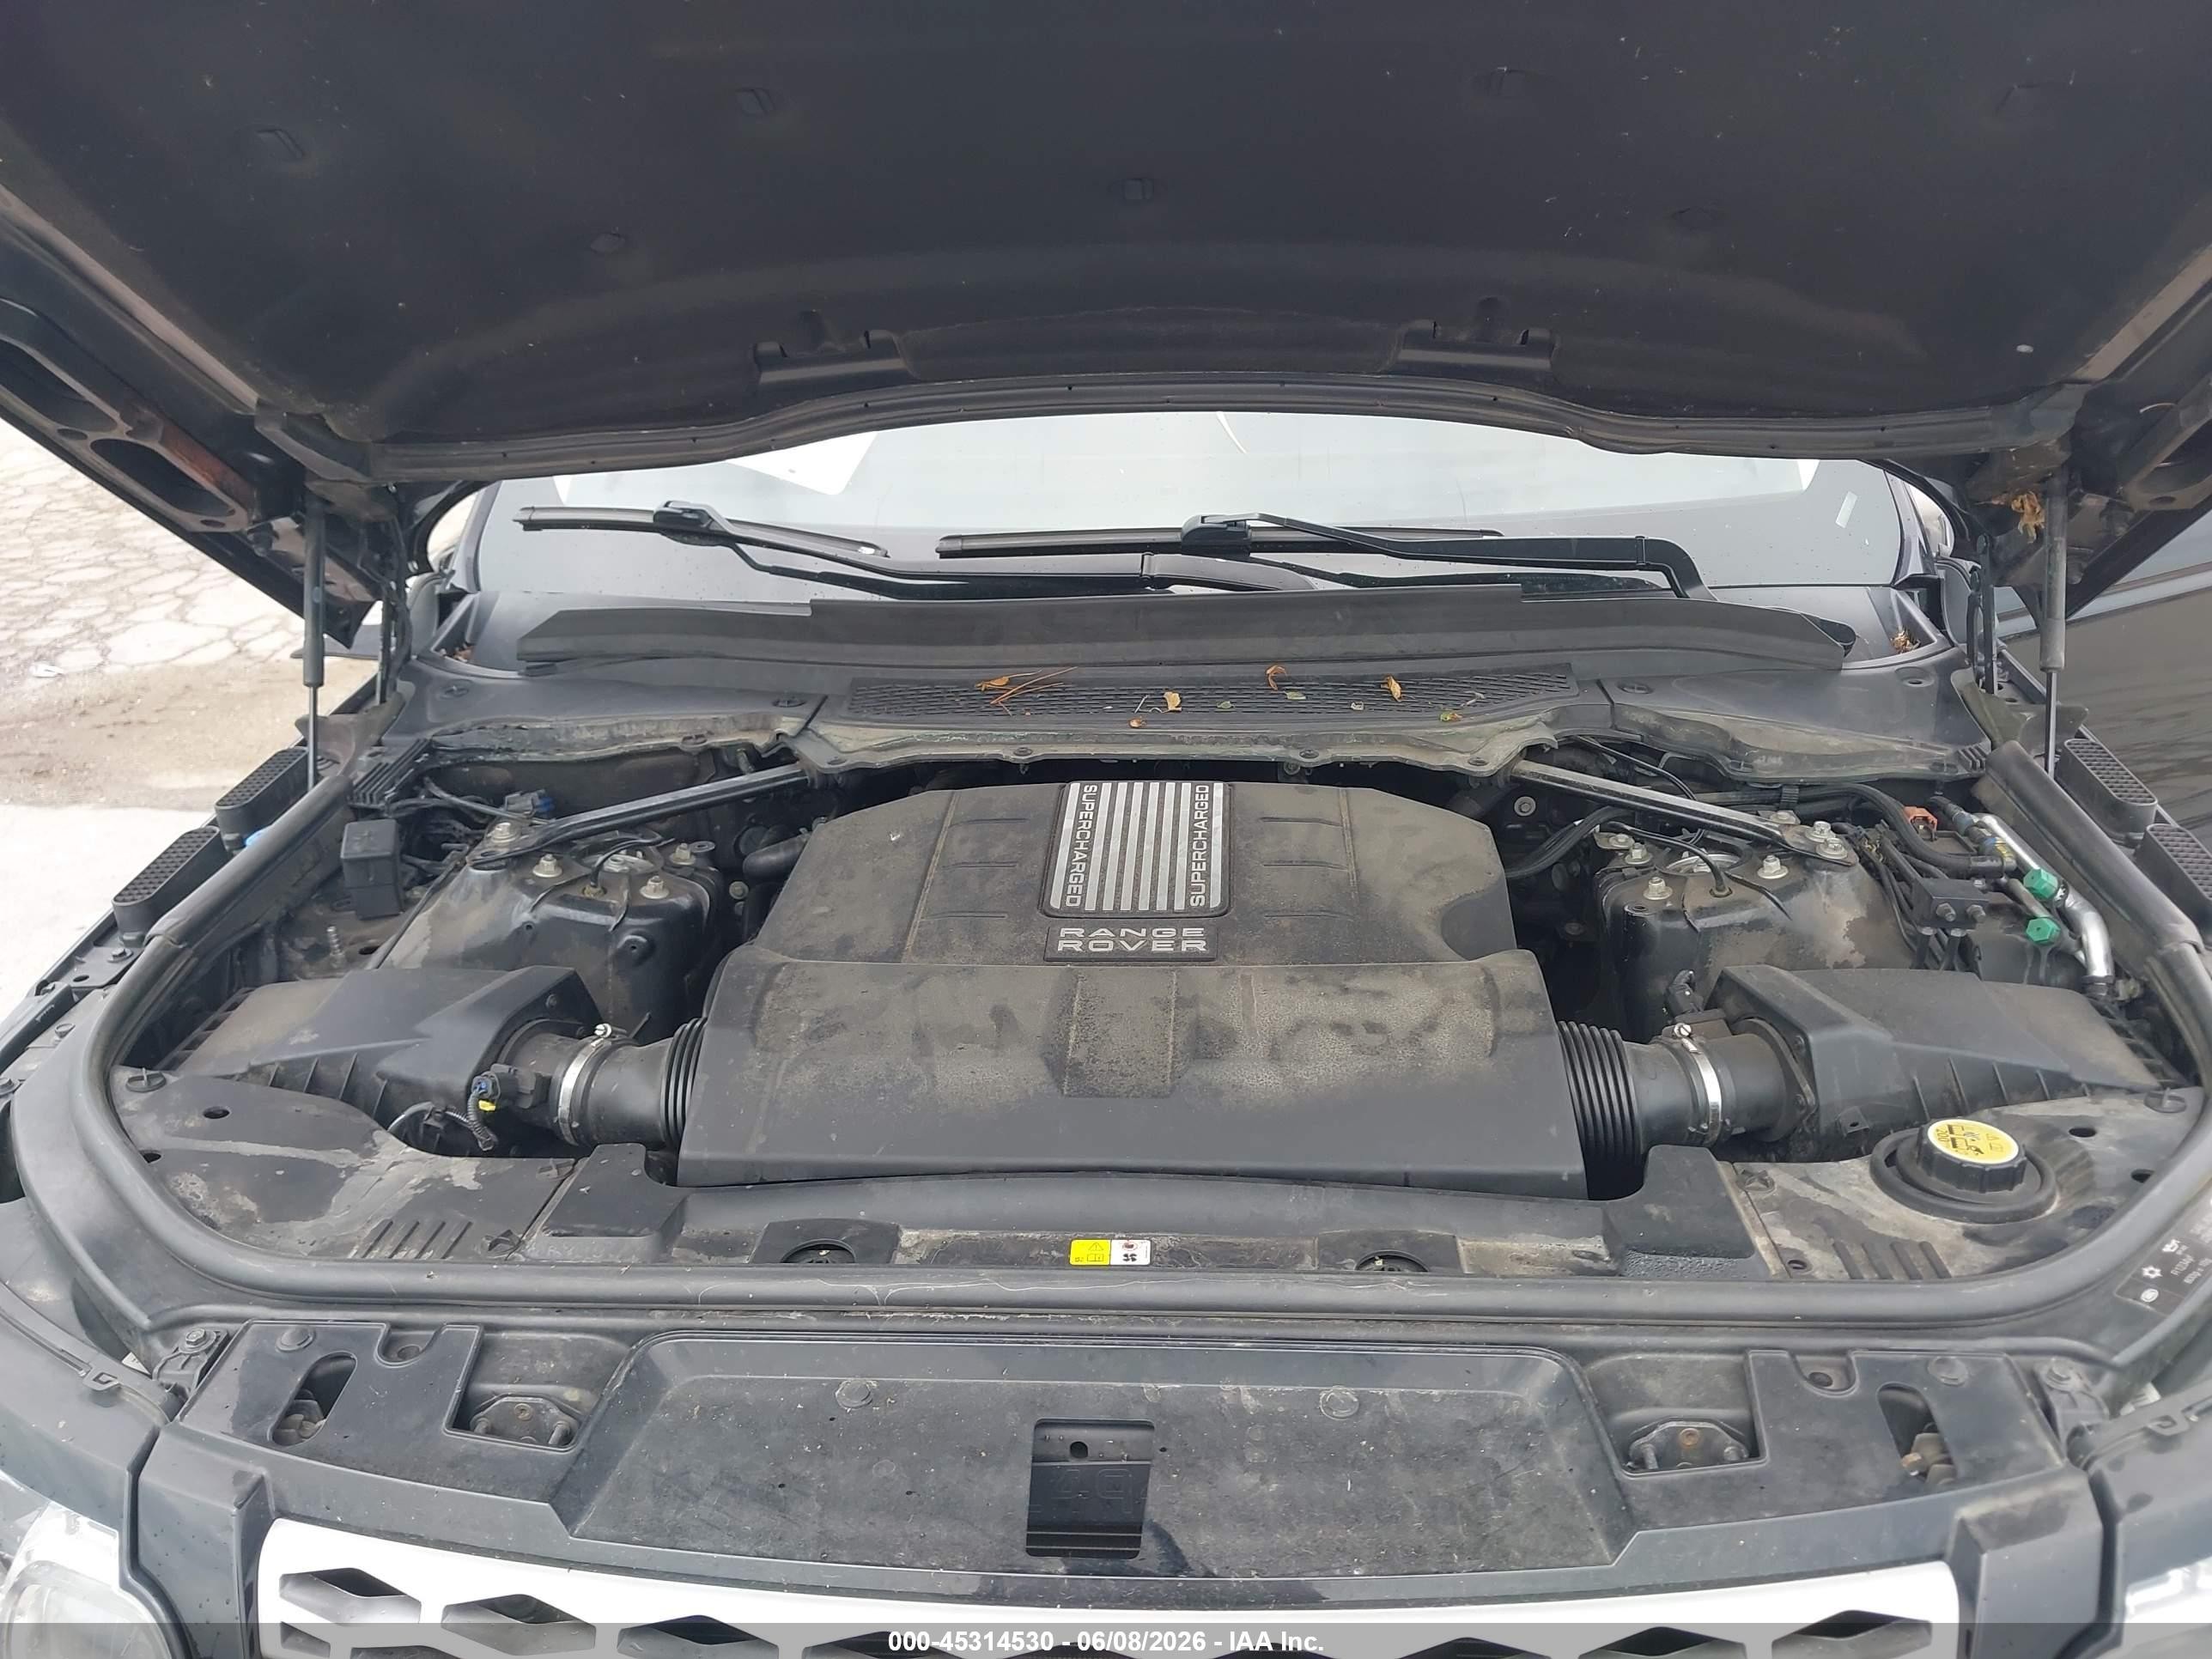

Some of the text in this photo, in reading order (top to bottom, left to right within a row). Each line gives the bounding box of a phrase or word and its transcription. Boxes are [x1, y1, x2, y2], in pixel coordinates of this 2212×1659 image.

[1065, 784, 1098, 907] SUPERCHARGED
[1190, 785, 1210, 908] SUPERCHARGED
[1057, 939, 1208, 952] ROVER
[1060, 927, 1206, 938] RANGE
